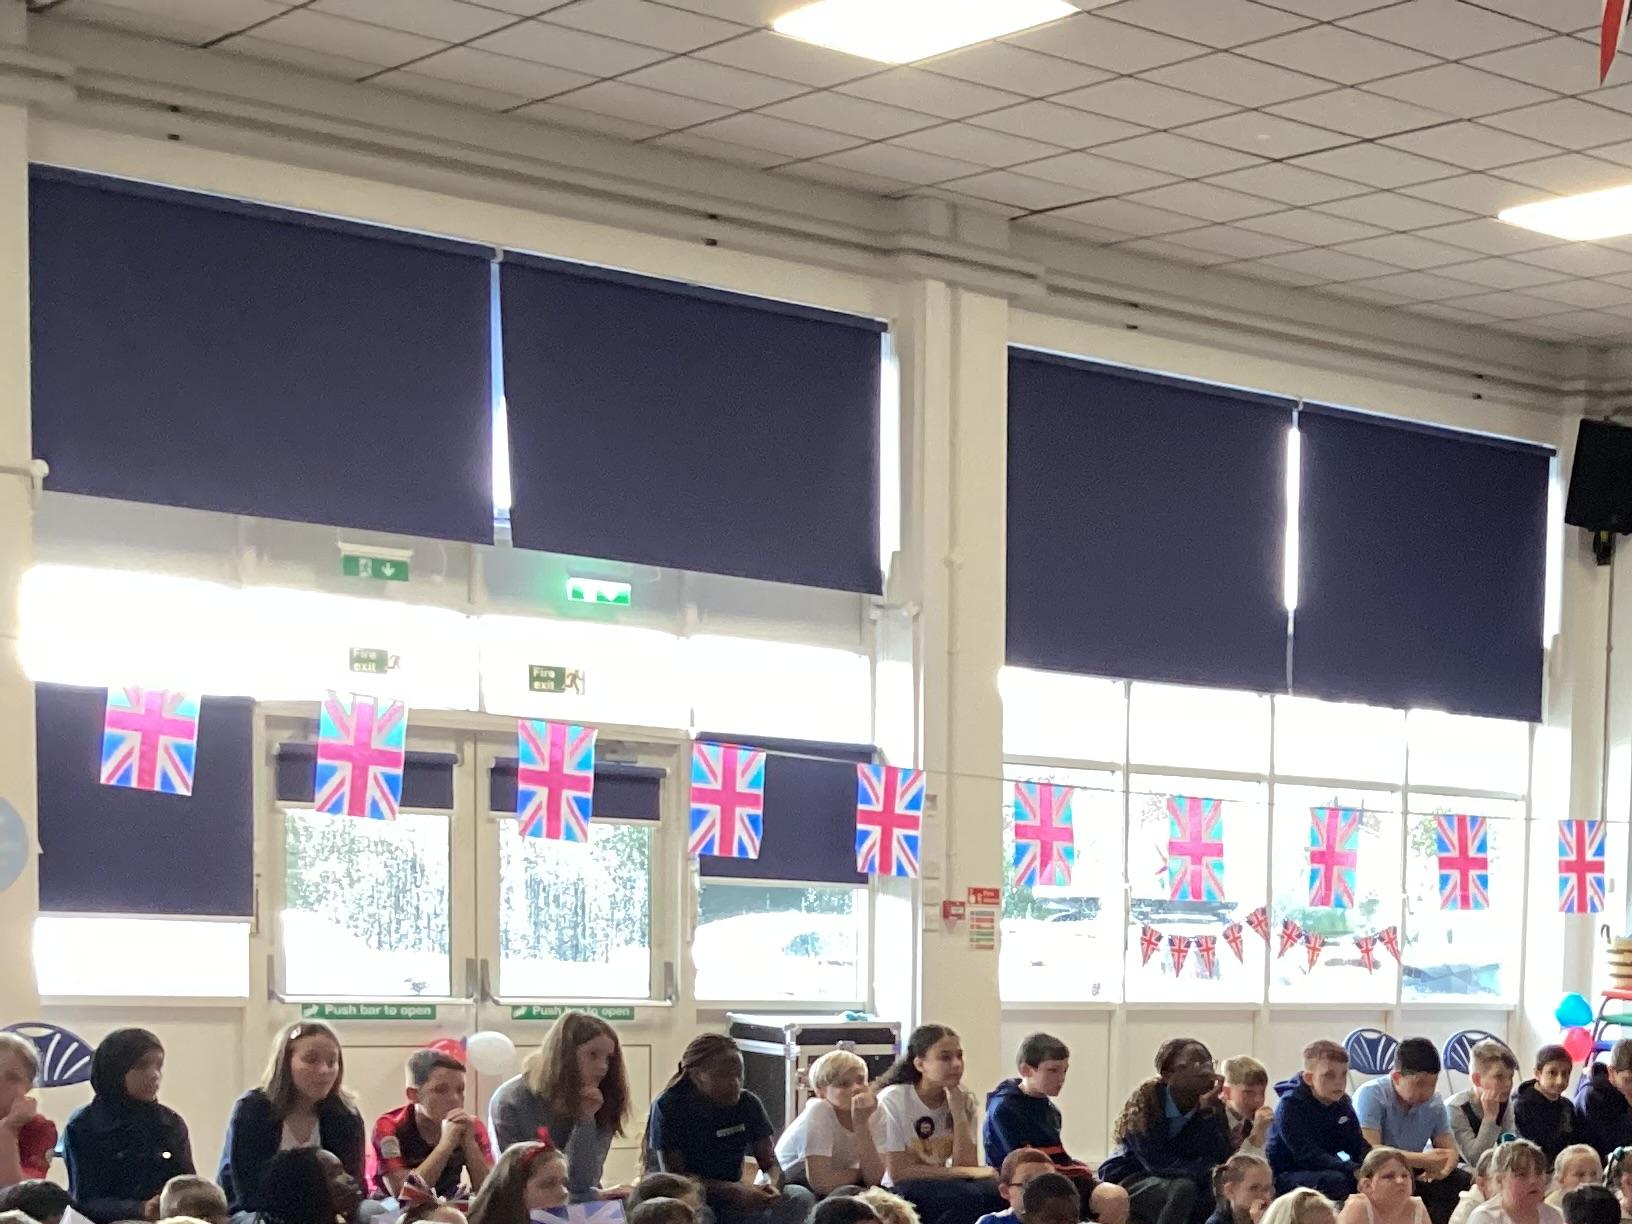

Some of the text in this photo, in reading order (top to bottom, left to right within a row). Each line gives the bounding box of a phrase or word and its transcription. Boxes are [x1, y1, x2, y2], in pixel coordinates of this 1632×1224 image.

[353, 648, 376, 659] Fire
[353, 662, 376, 672] exit
[533, 667, 555, 678] Fire
[533, 680, 555, 690] exit
[325, 1004, 431, 1017] Push bar to open
[532, 1006, 561, 1016] Push
[602, 1007, 630, 1017] open
